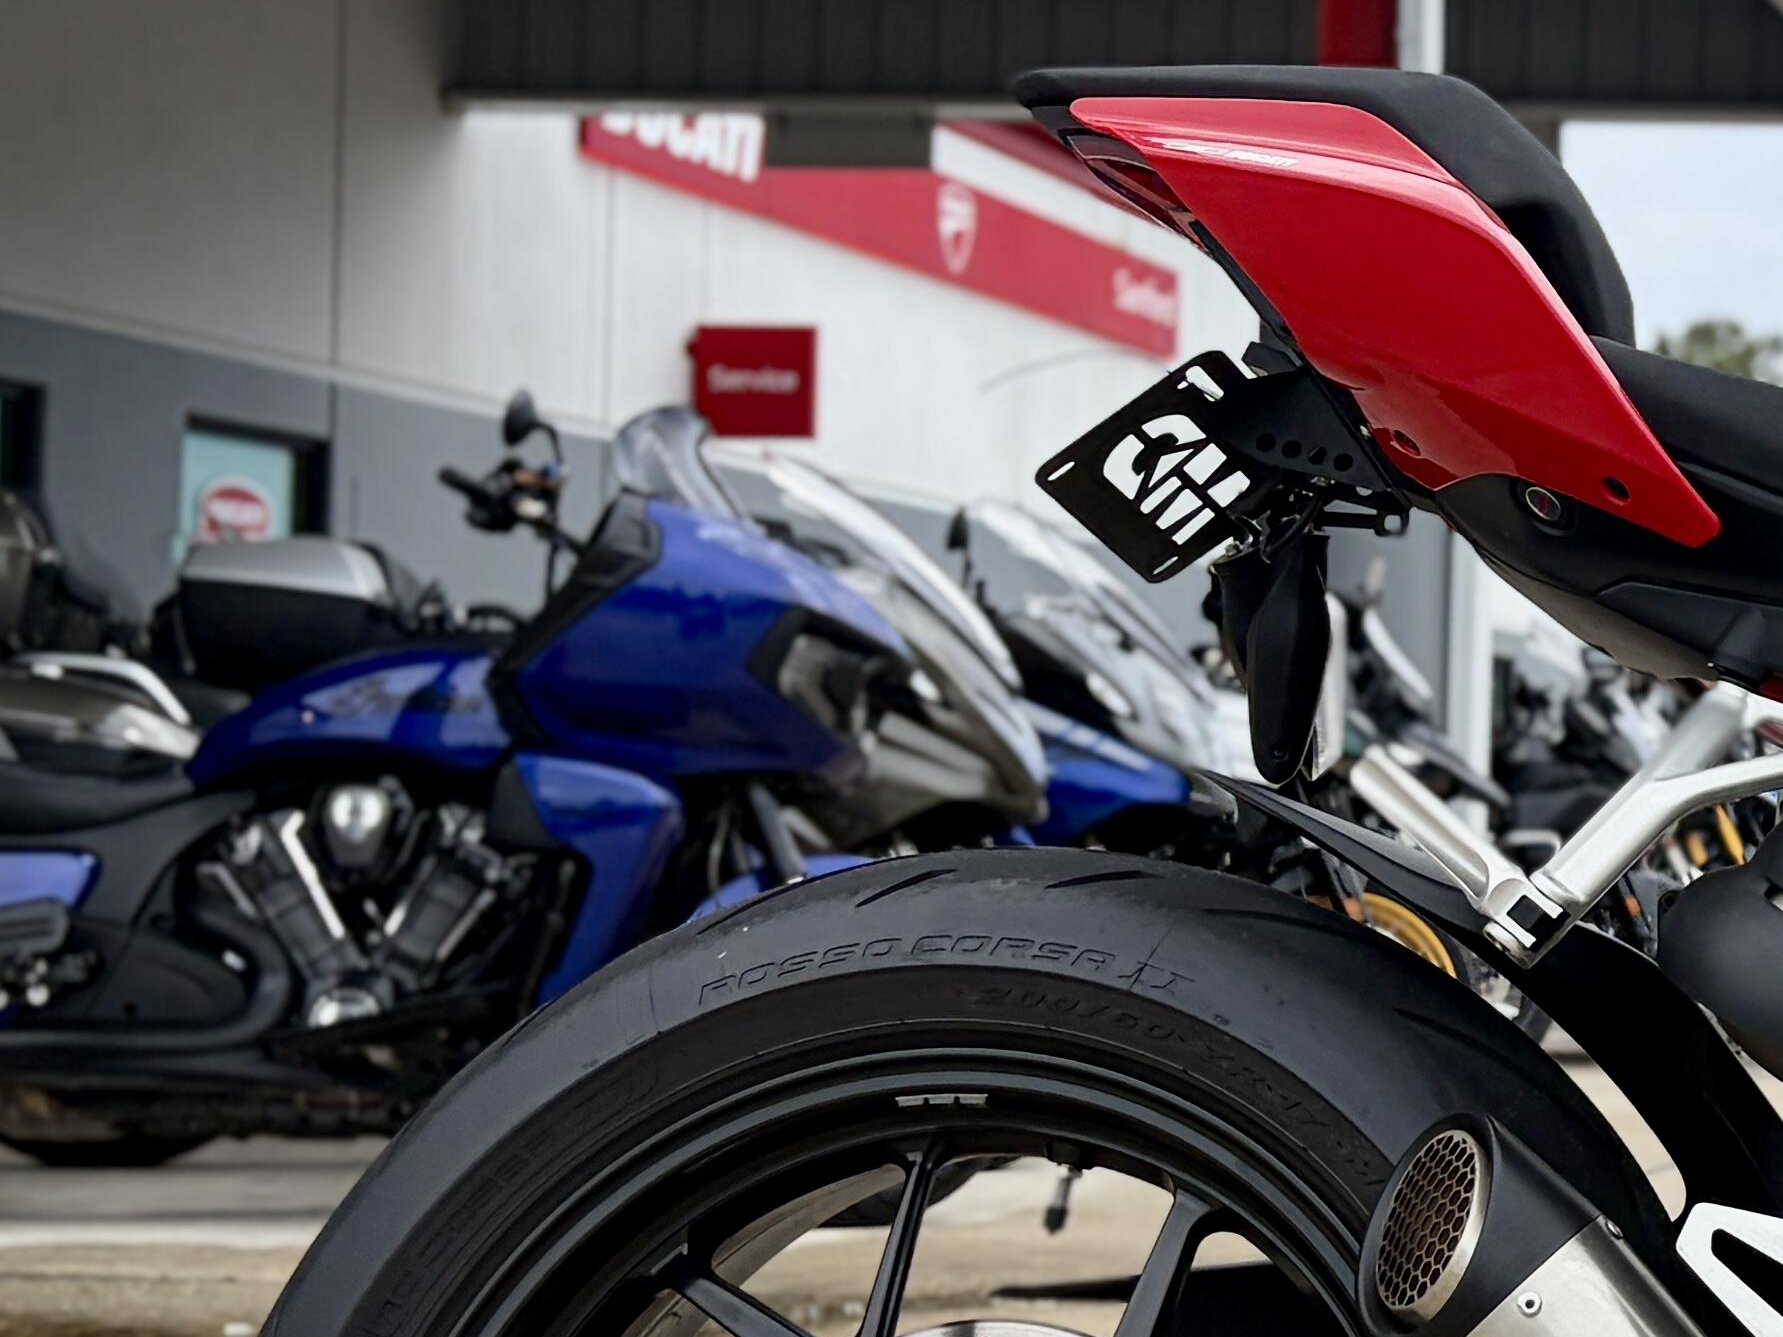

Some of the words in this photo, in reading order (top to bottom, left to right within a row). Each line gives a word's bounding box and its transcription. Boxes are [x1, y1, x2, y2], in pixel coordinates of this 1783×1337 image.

[705, 362, 801, 396] Service
[698, 937, 895, 1007] ROSSO
[911, 933, 1110, 975] CORSA
